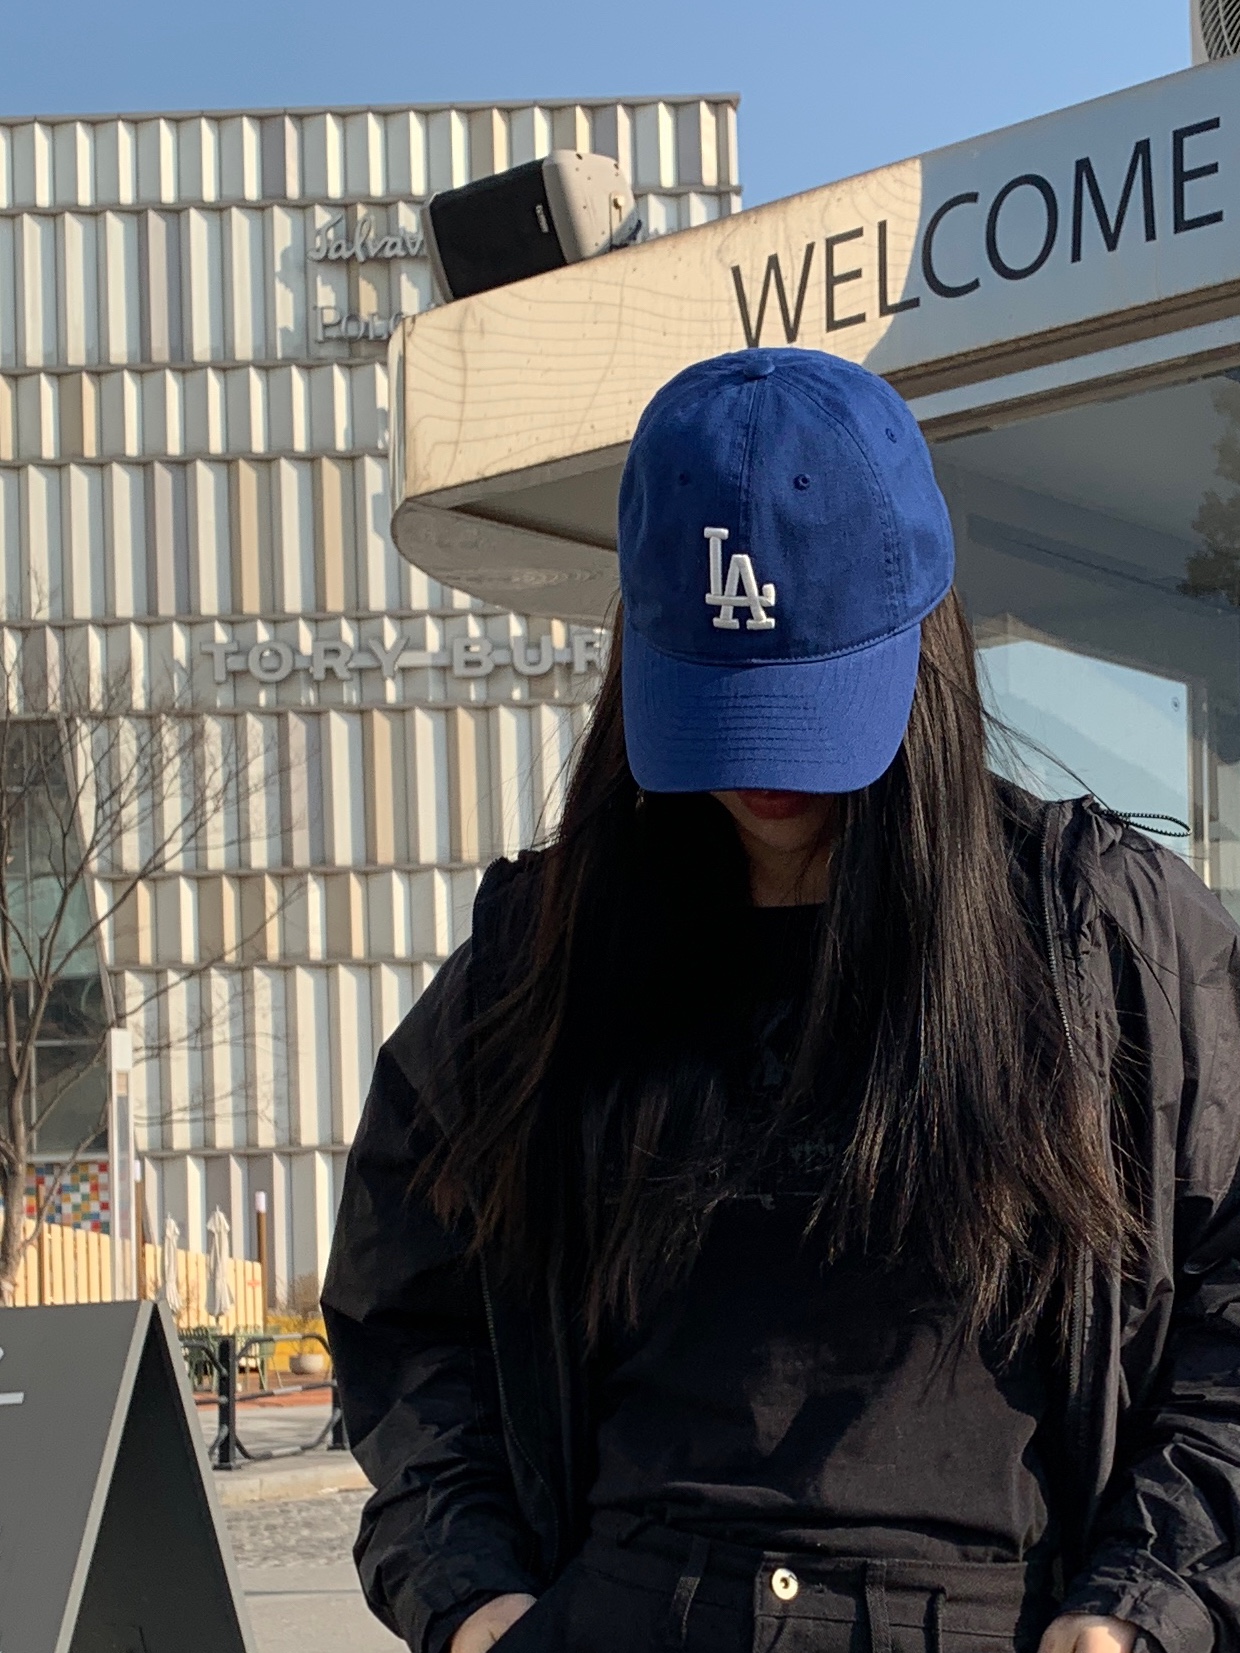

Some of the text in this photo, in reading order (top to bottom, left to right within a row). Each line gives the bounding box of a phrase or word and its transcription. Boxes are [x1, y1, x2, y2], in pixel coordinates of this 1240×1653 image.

[730, 116, 1224, 349] WELCOME
[703, 526, 776, 630] LA
[200, 636, 409, 684] TORY
